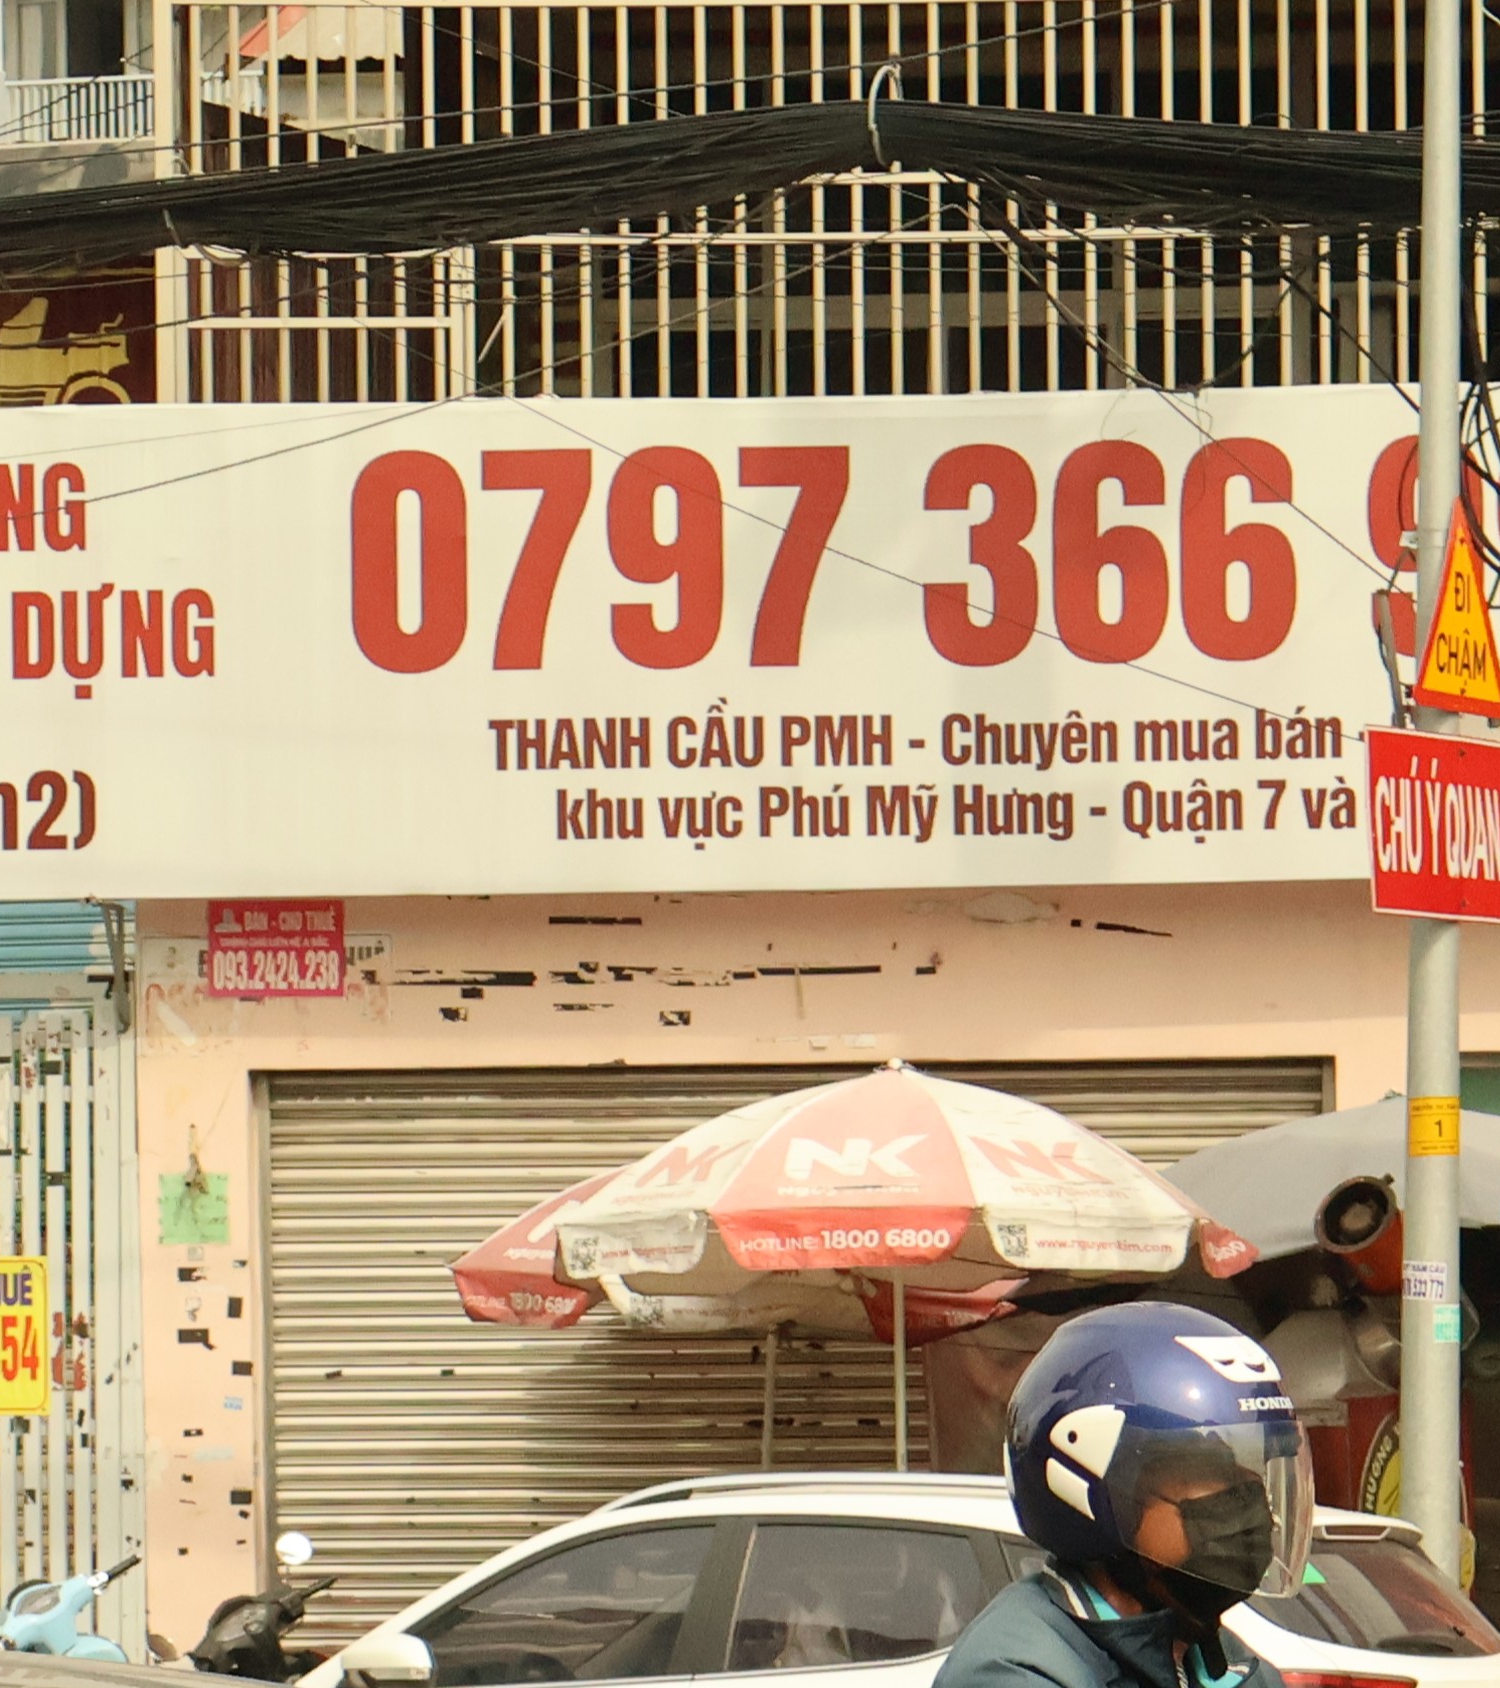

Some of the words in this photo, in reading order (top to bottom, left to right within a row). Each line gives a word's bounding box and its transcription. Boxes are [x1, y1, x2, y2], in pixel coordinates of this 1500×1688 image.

[350, 445, 850, 673] 0797
[923, 436, 1296, 668] 366
[1452, 571, 1472, 614] ĐI
[12, 583, 215, 700] DỰNG
[1436, 633, 1487, 685] CHẬM
[489, 717, 650, 771] THANH
[667, 696, 764, 768] CẦU
[781, 714, 892, 767] PMH
[941, 711, 1117, 772] Chuyên
[1134, 719, 1239, 762] mua
[1254, 705, 1343, 760] bán
[557, 788, 643, 841] khu
[660, 790, 743, 850] vực
[760, 783, 849, 838] Phú
[866, 783, 937, 842] Mỹ
[954, 784, 1074, 842] Hưng
[1123, 778, 1244, 843] Quận
[1256, 780, 1287, 831] 7
[1301, 776, 1356, 830] và
[1375, 754, 1422, 874] CHÚ
[1425, 758, 1443, 876] Ý
[213, 950, 339, 991] 093.2424.238
[1434, 1119, 1443, 1138] 1
[784, 1134, 929, 1180] NK
[969, 1136, 1116, 1184] NK
[821, 1229, 879, 1250] 1800
[885, 1228, 950, 1249] 6800
[1034, 1237, 1173, 1254] www.nguyenkim.com
